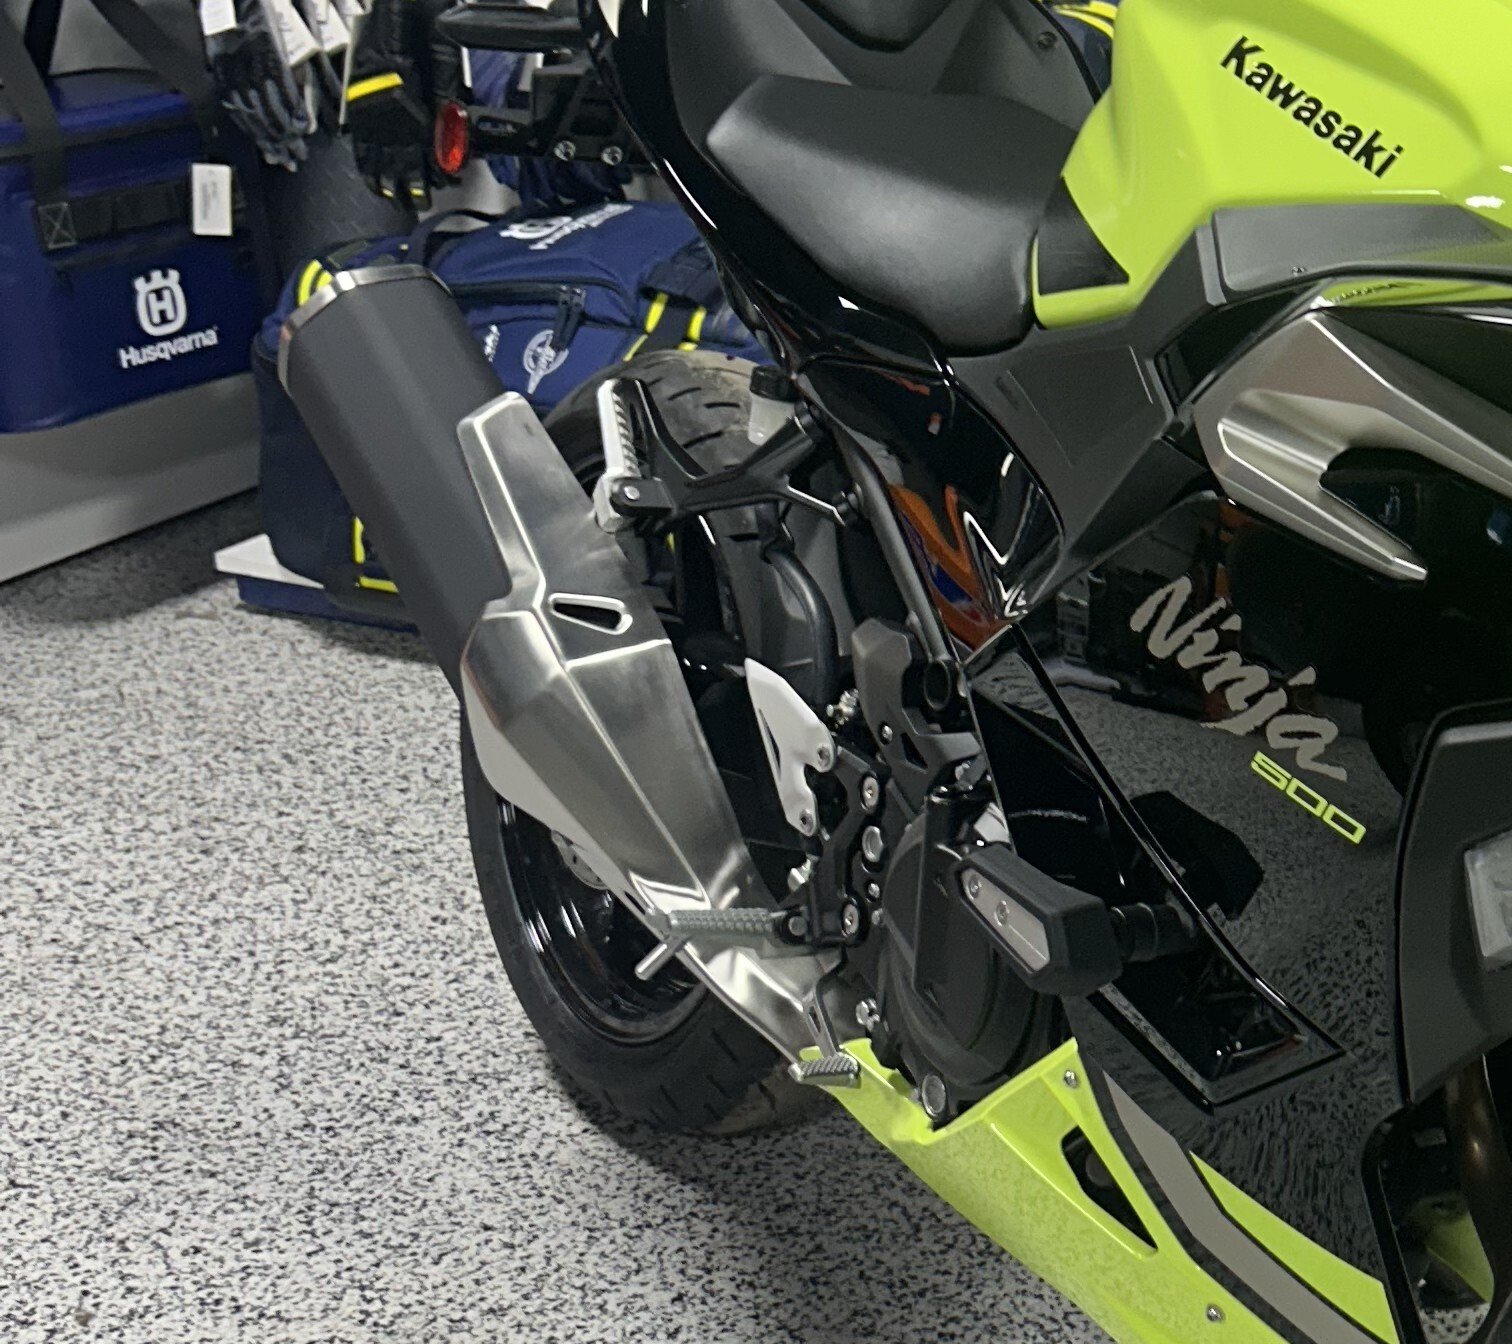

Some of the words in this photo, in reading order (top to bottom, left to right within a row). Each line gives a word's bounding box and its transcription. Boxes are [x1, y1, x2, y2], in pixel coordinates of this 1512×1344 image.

[1219, 34, 1405, 180] Kawasaki
[119, 328, 219, 369] Husqvarna
[1129, 575, 1348, 783] Ninja
[1250, 749, 1367, 845] 500
